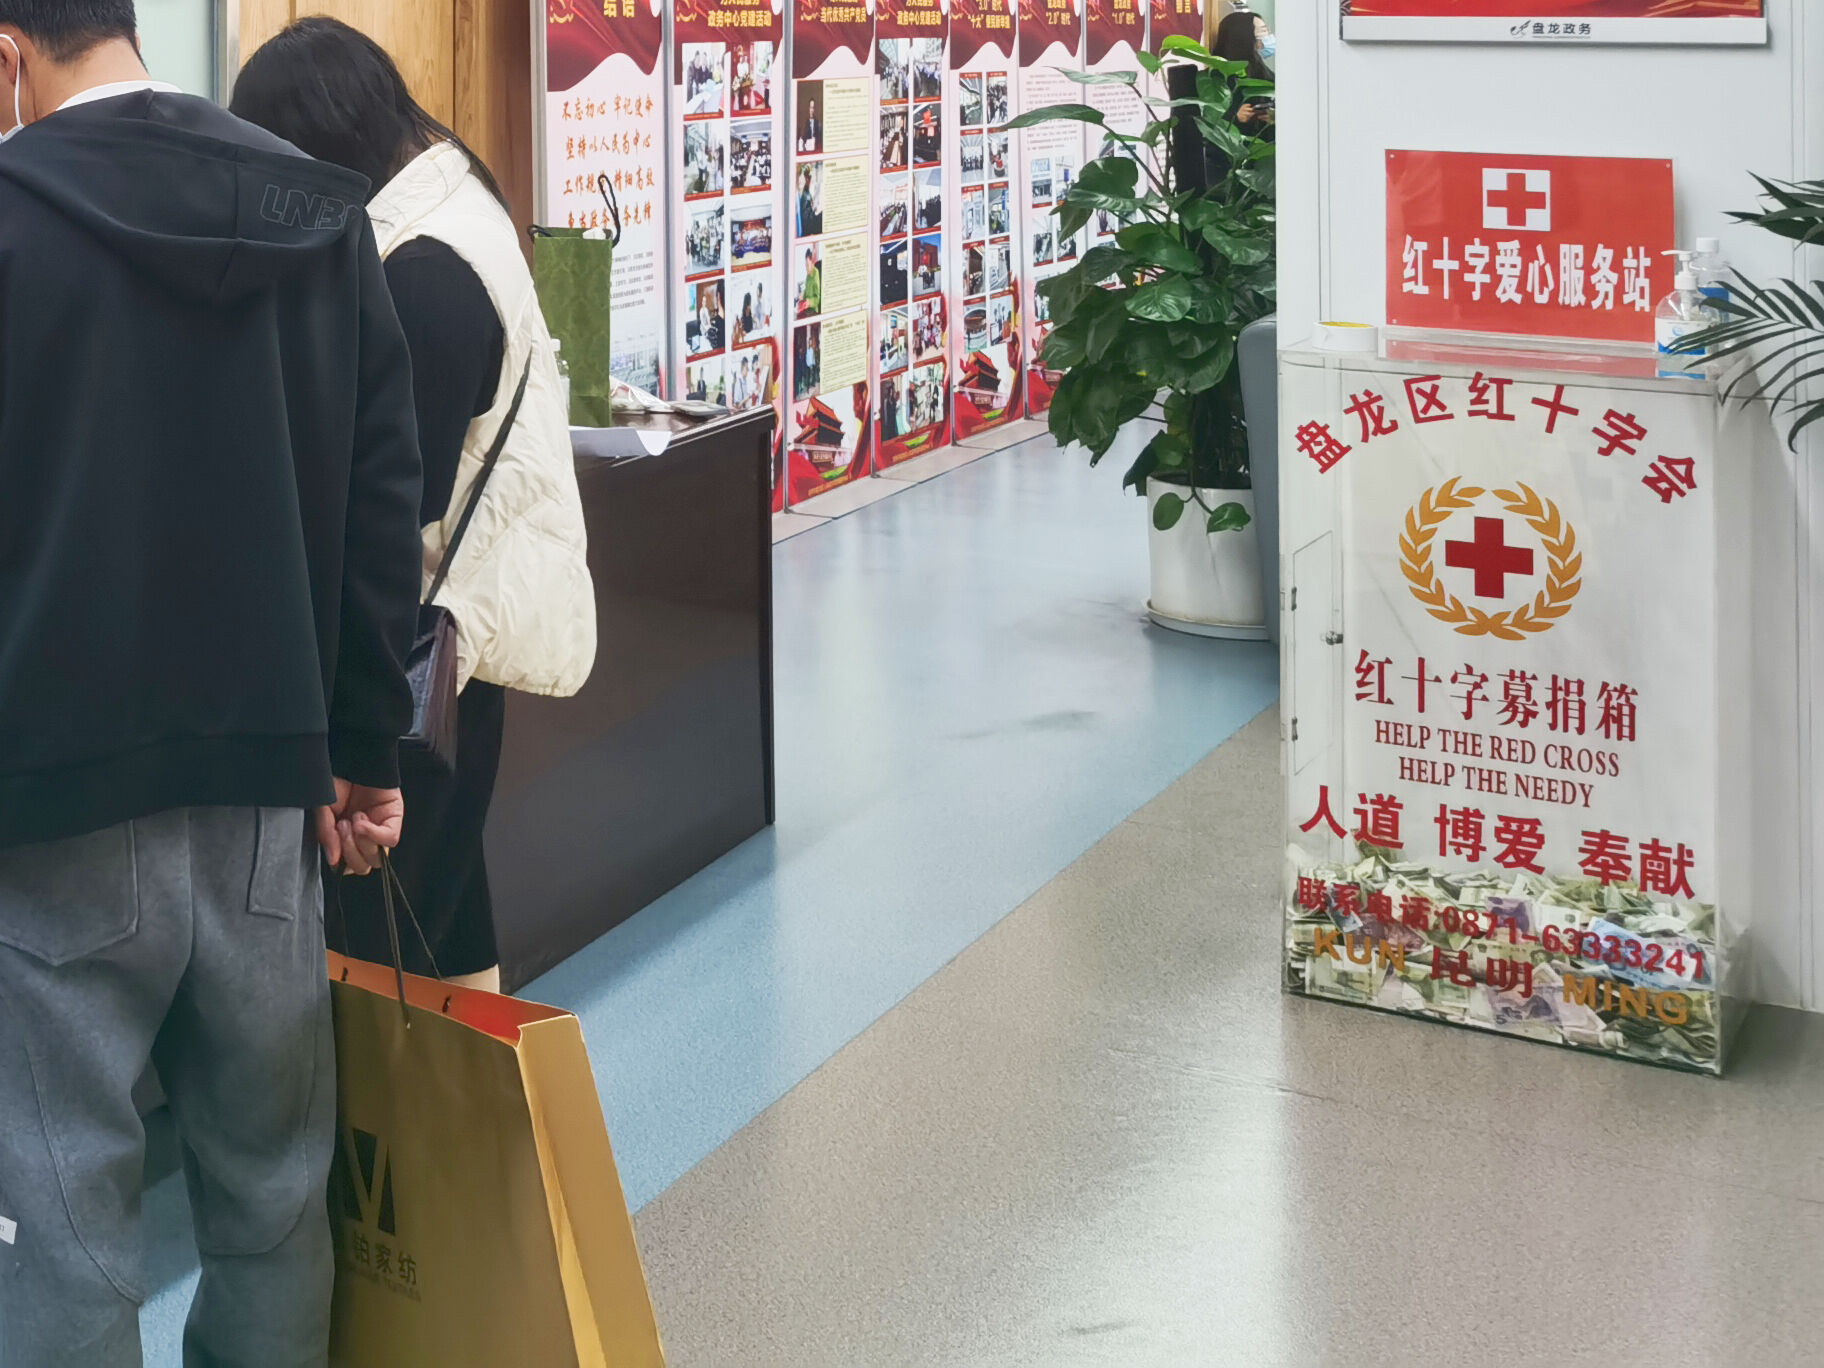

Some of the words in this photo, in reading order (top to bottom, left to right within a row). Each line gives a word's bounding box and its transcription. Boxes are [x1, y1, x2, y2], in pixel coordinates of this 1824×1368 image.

[1532, 20, 1593, 37] 盘龙政务
[1401, 234, 1652, 313] 红十字爱心服务站
[1294, 371, 1699, 504] 盘龙区红十字会
[1353, 648, 1639, 742] 红十字募捐箱
[1375, 719, 1432, 750] HELP
[1438, 728, 1484, 757] THE
[1489, 735, 1537, 765] RED
[1543, 743, 1621, 778] CROSS
[1398, 756, 1456, 788] HELP
[1462, 765, 1509, 796] THE
[1514, 773, 1595, 808] NEEDY
[1299, 785, 1405, 851] 人道
[1434, 803, 1547, 875] 博爱
[1578, 828, 1696, 900] 奉献
[1312, 926, 1406, 972] KUN
[1430, 945, 1534, 999] 昆明
[1561, 972, 1689, 1026] MING
